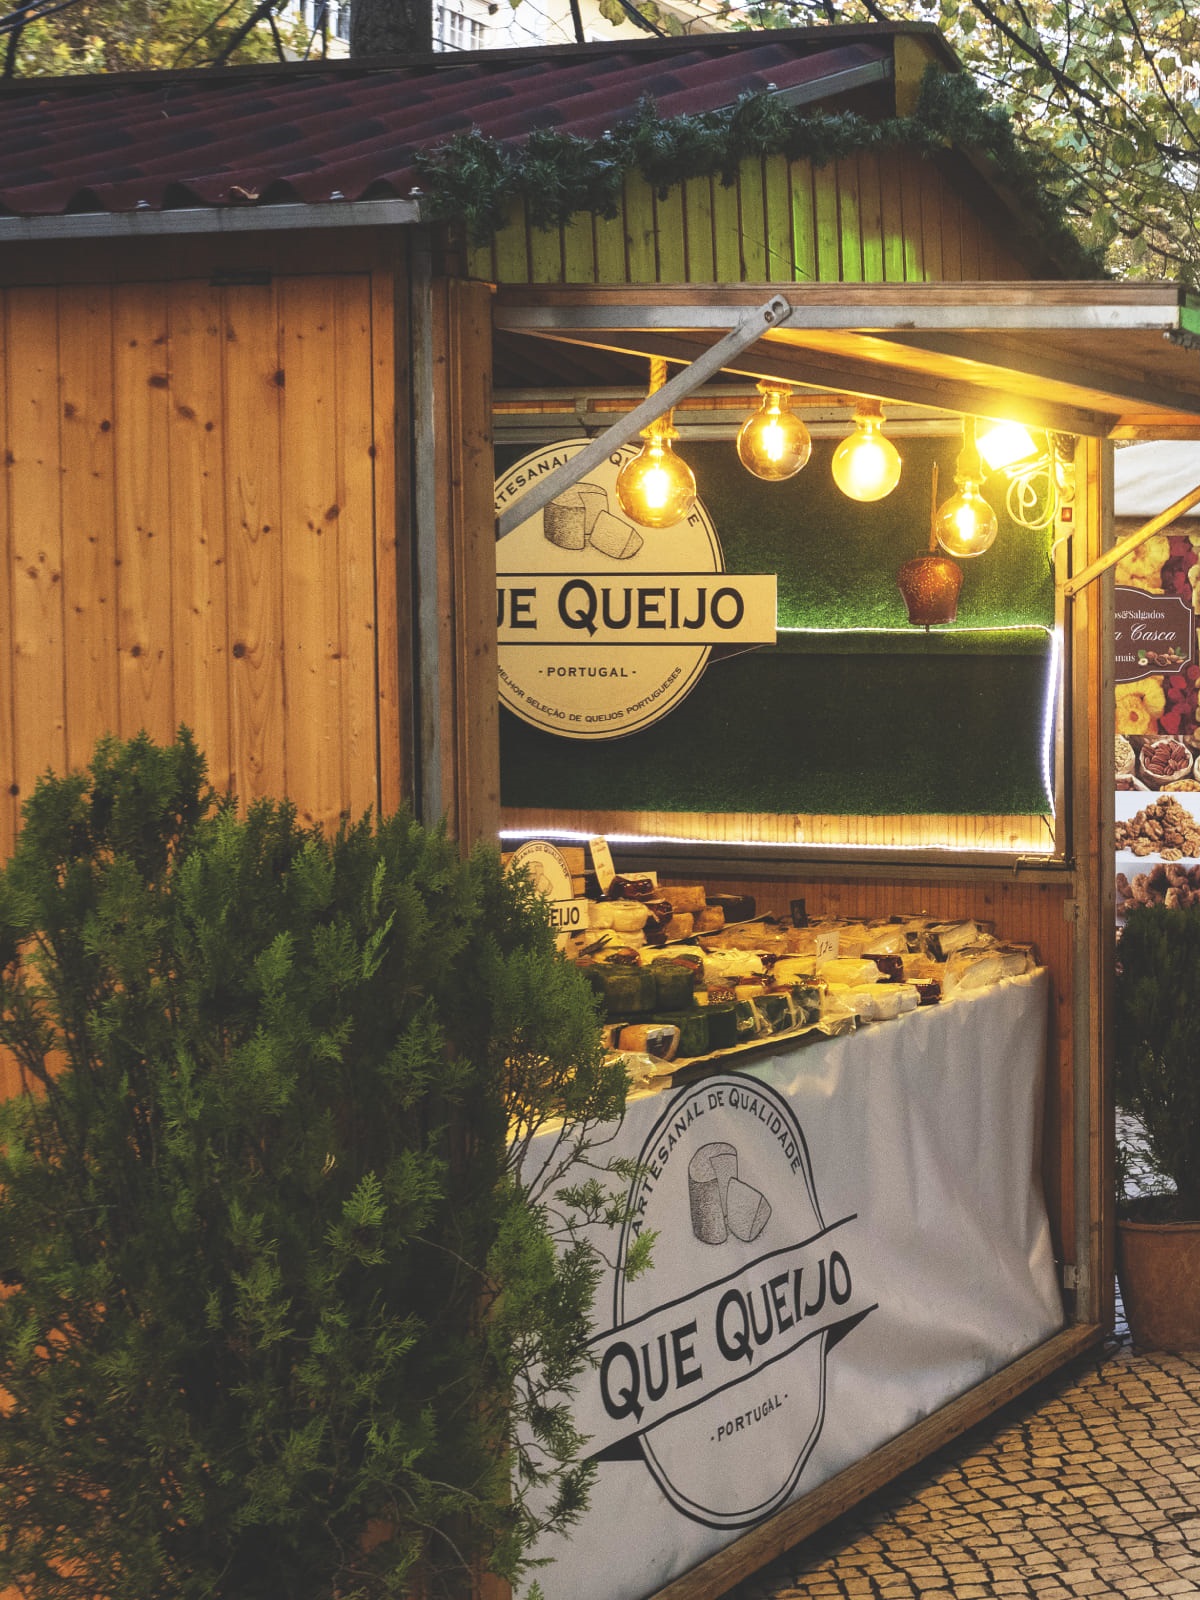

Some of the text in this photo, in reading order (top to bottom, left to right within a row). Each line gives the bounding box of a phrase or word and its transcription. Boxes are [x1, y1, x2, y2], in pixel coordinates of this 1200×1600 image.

[558, 579, 745, 637] QUEIJO
[1130, 623, 1177, 642] Casca
[526, 696, 566, 719] SELEÇÃO
[569, 713, 582, 722] DE
[585, 710, 624, 723] QUEIJOS
[626, 666, 682, 715] PORTUGUESES
[550, 906, 580, 927] EIJO
[631, 1088, 801, 1238] ARTESANAL DE QUALIDADE
[600, 1250, 852, 1424] QUE QUEIJO
